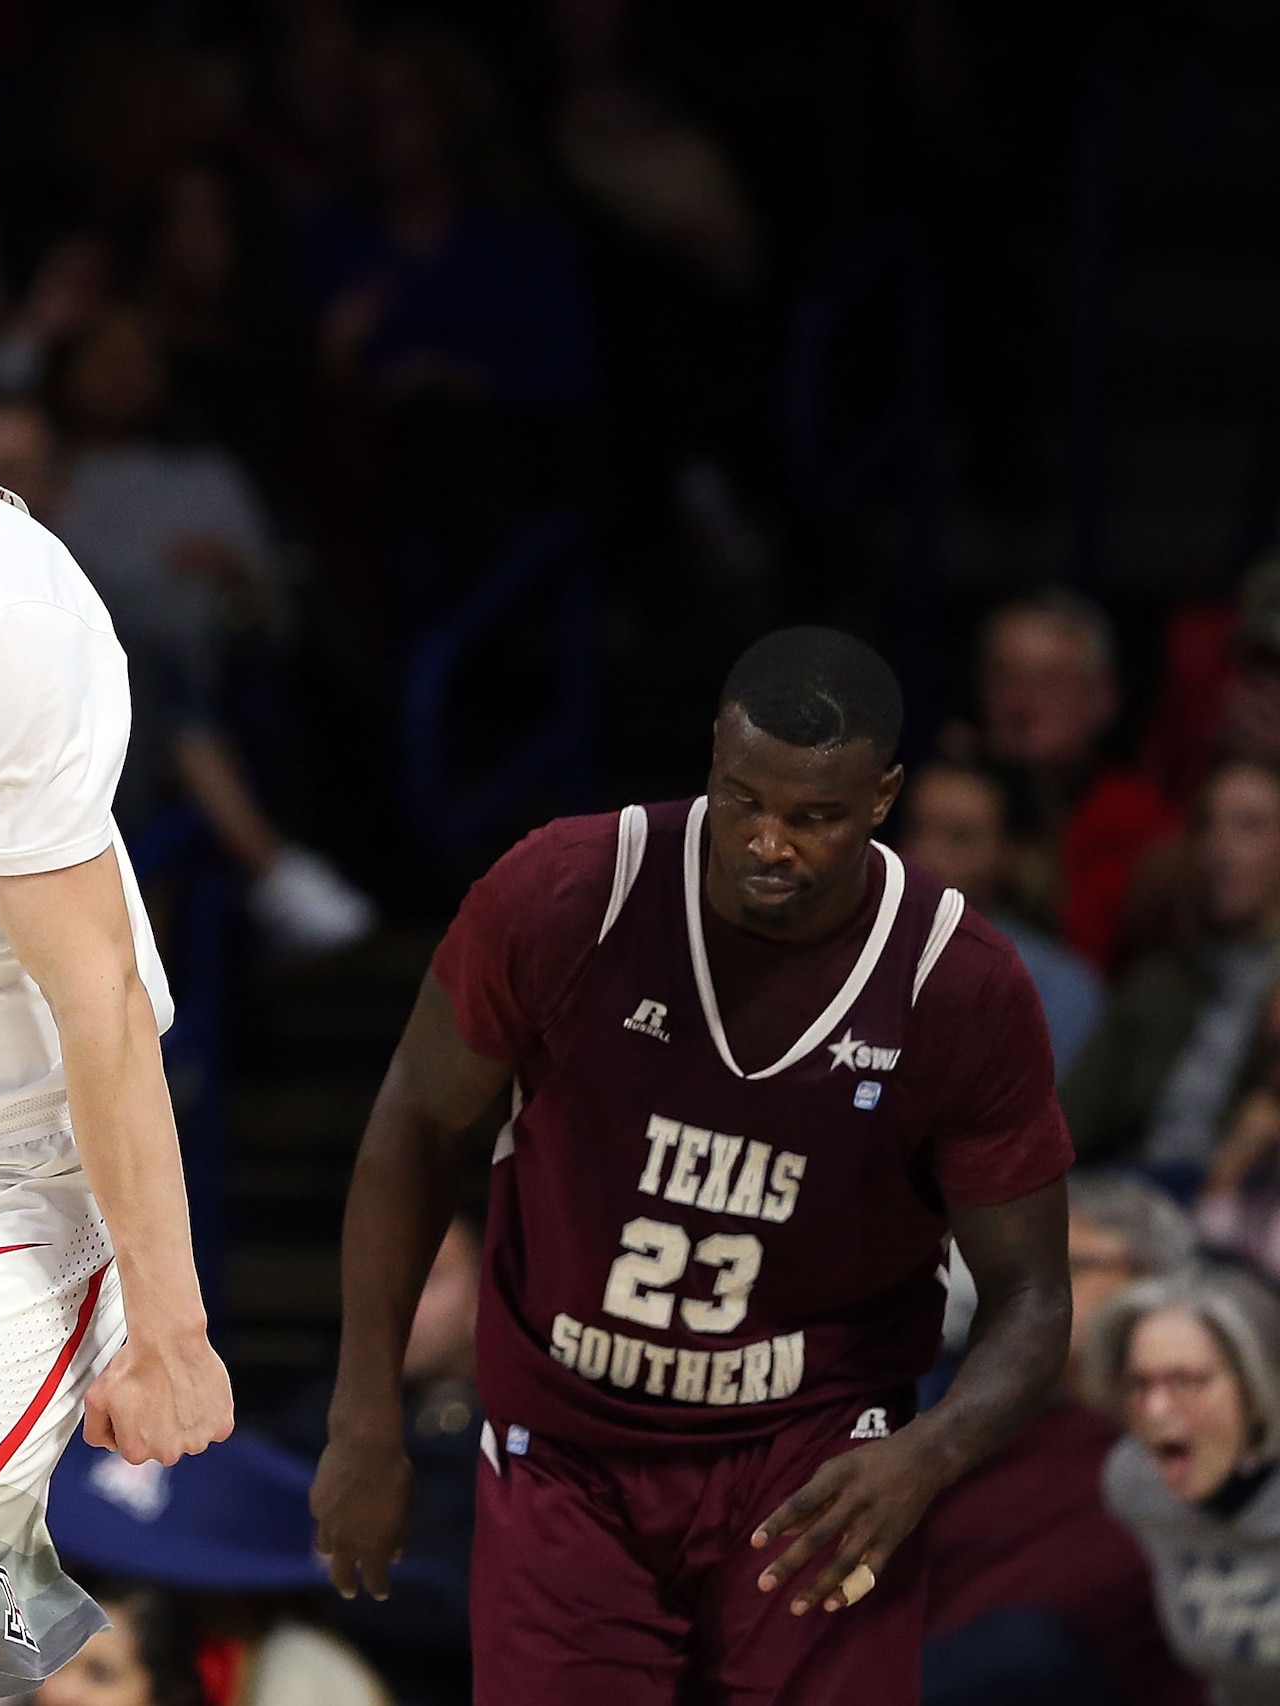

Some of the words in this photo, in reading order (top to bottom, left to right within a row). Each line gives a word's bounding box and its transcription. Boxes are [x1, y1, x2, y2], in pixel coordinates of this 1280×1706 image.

[637, 1113, 808, 1224] TEXAS
[602, 1216, 764, 1333] 23
[550, 1312, 805, 1405] SOUTHERN
